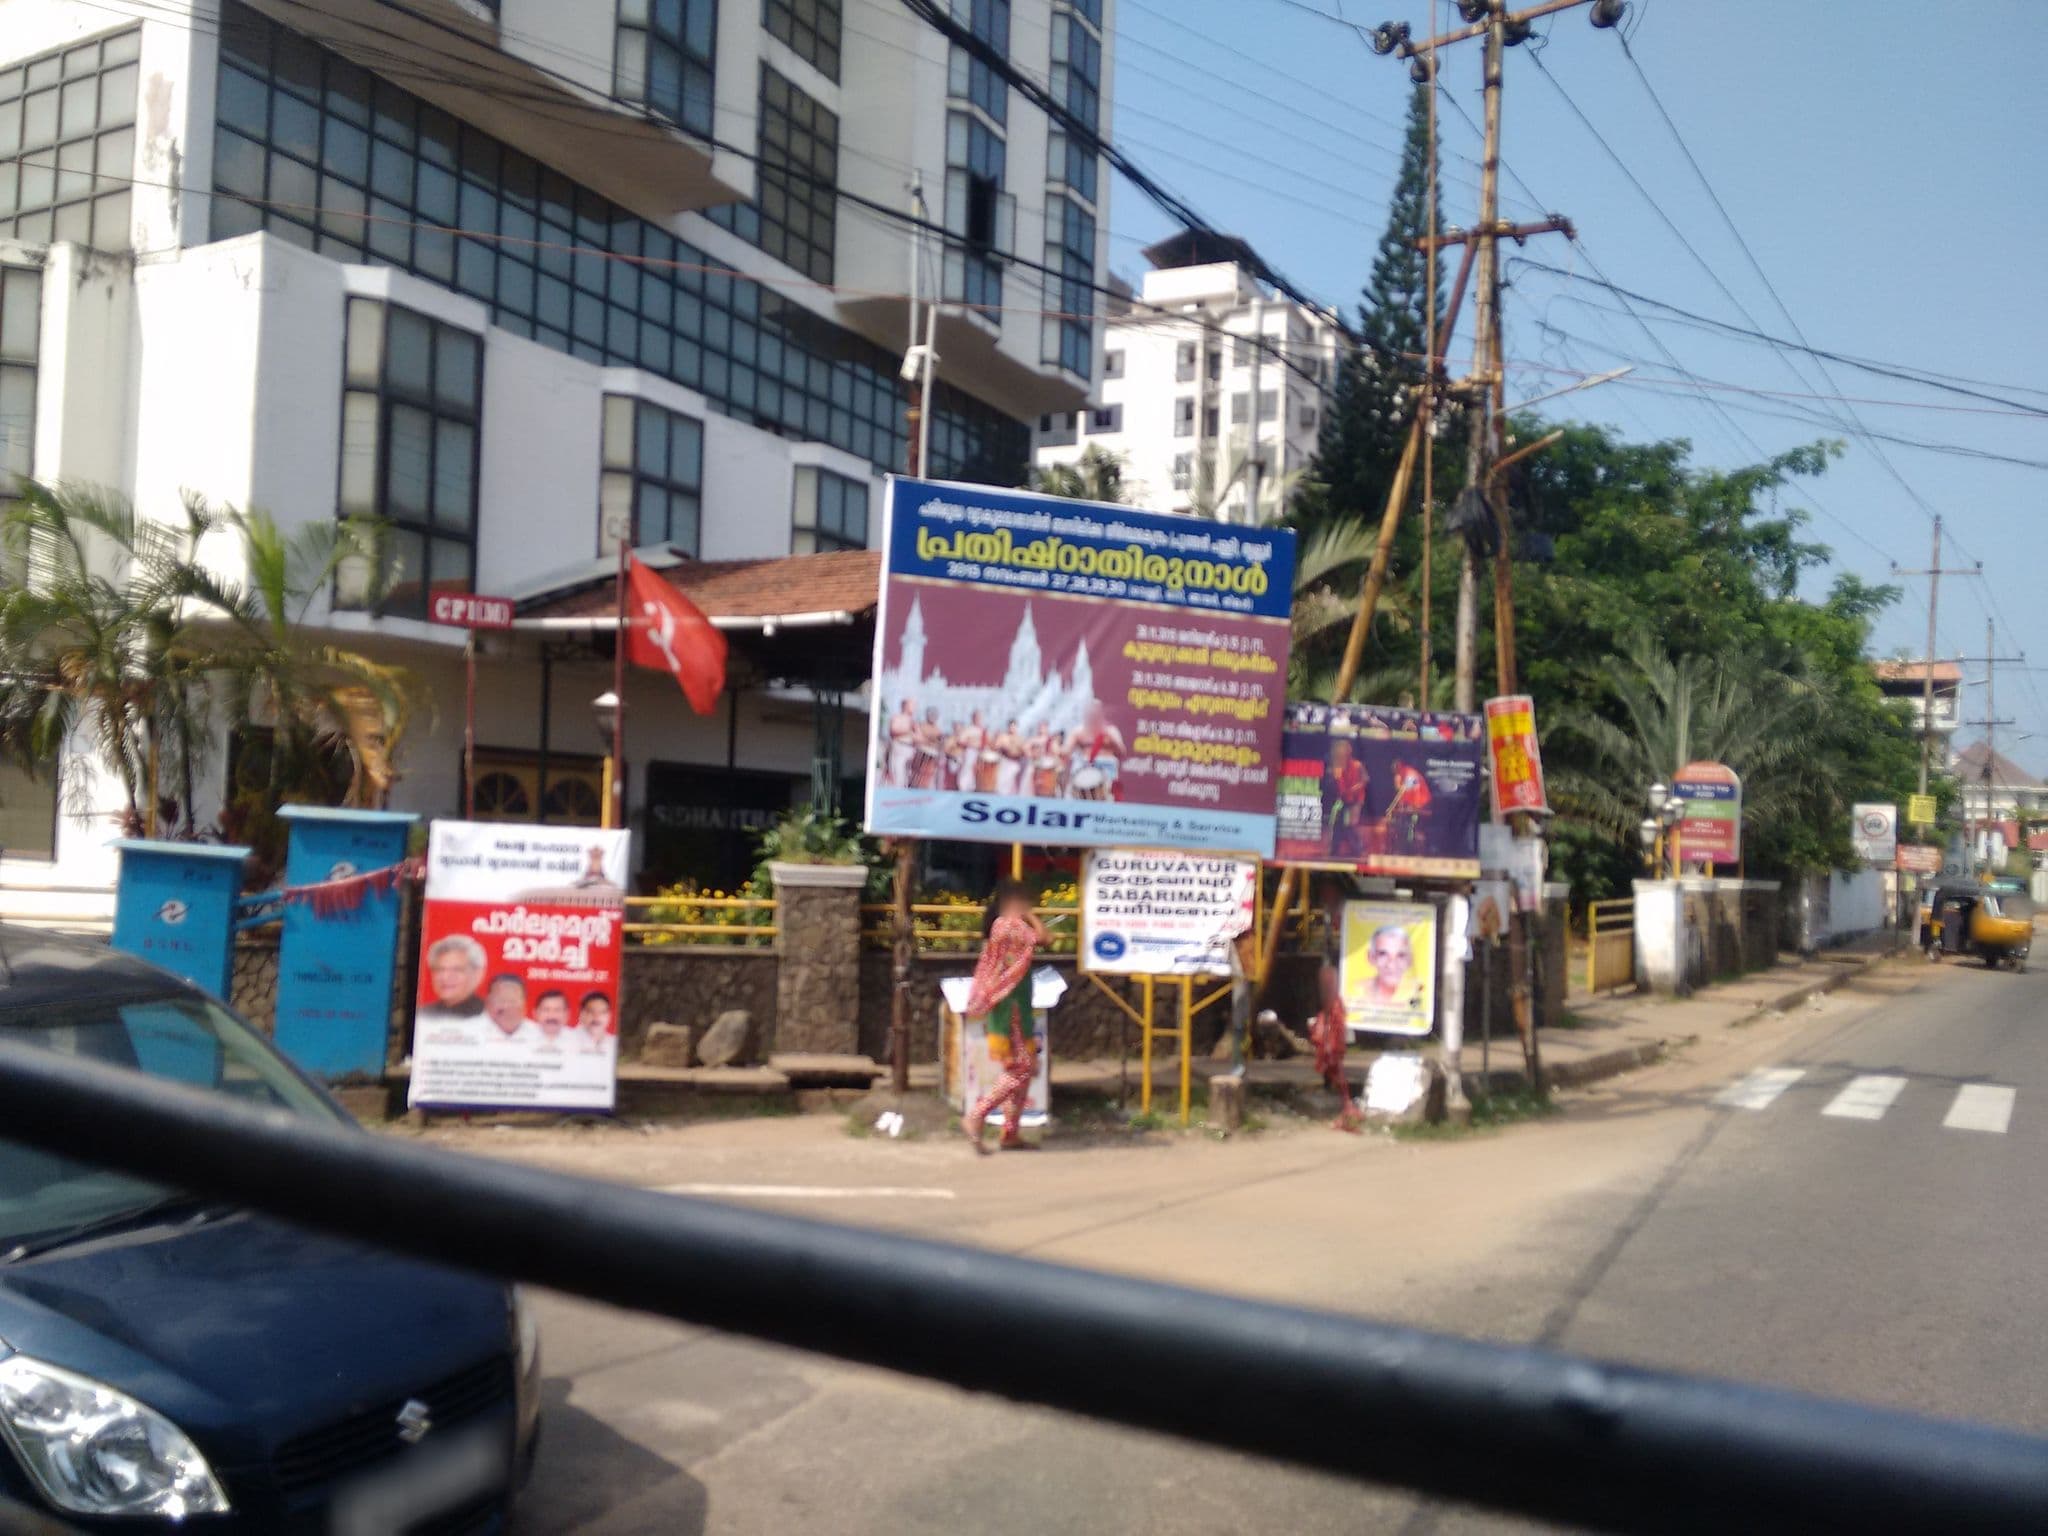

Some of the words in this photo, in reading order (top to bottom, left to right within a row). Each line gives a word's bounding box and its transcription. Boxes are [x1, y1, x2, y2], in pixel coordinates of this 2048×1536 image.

[917, 525, 1268, 596] പ്രതിഷ്ഠാതിരുനാൾ
[435, 597, 510, 625] CPI(M)
[960, 799, 1091, 829] Solar
[1097, 857, 1237, 874] GURUVAYUR
